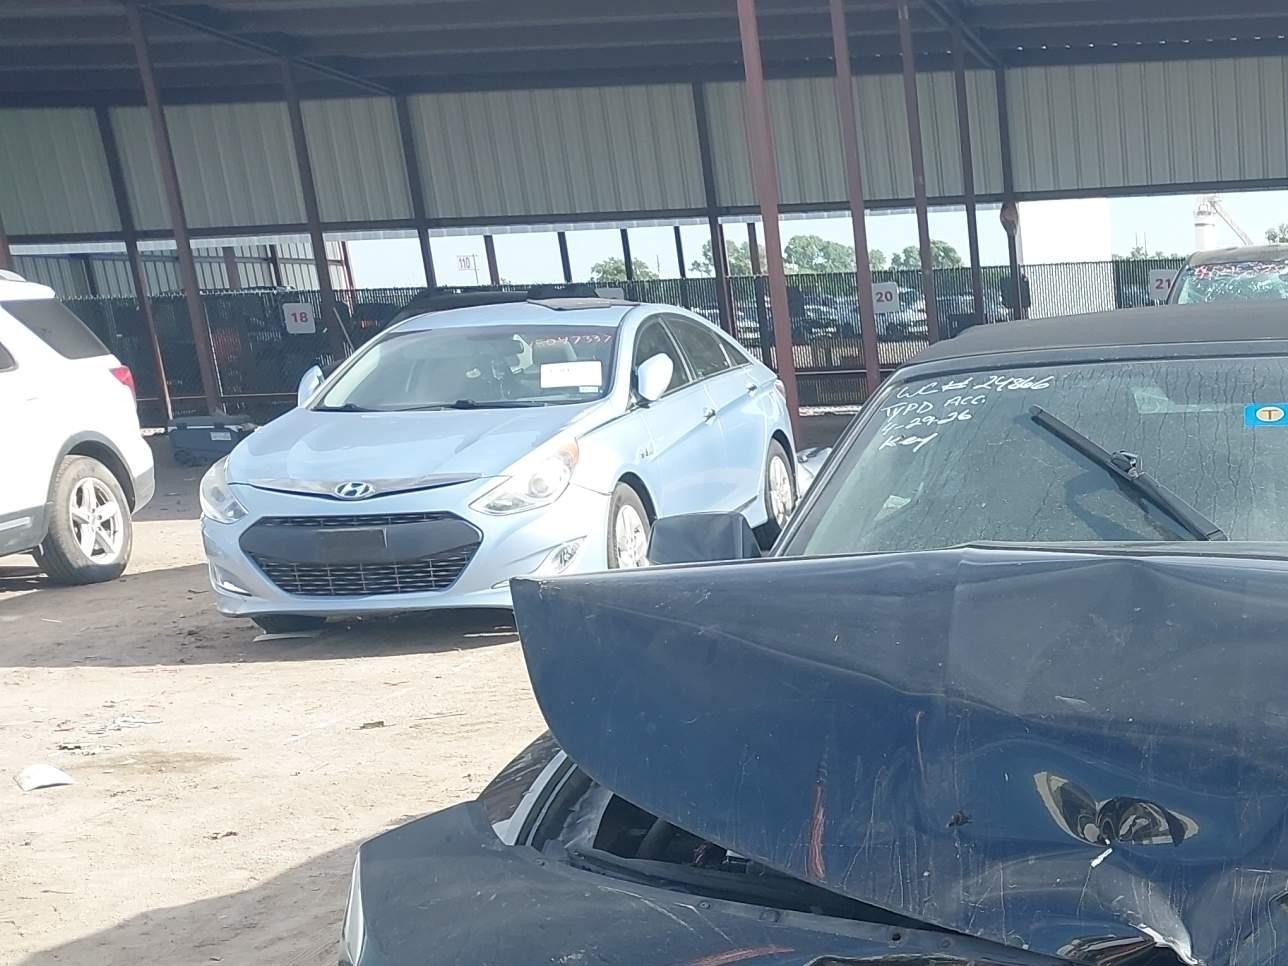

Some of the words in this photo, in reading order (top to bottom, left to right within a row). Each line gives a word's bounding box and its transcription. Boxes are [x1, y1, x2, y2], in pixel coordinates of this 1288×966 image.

[1155, 278, 1171, 290] 21
[875, 291, 893, 302] 20
[291, 311, 309, 323] 18
[1262, 409, 1280, 420] T
